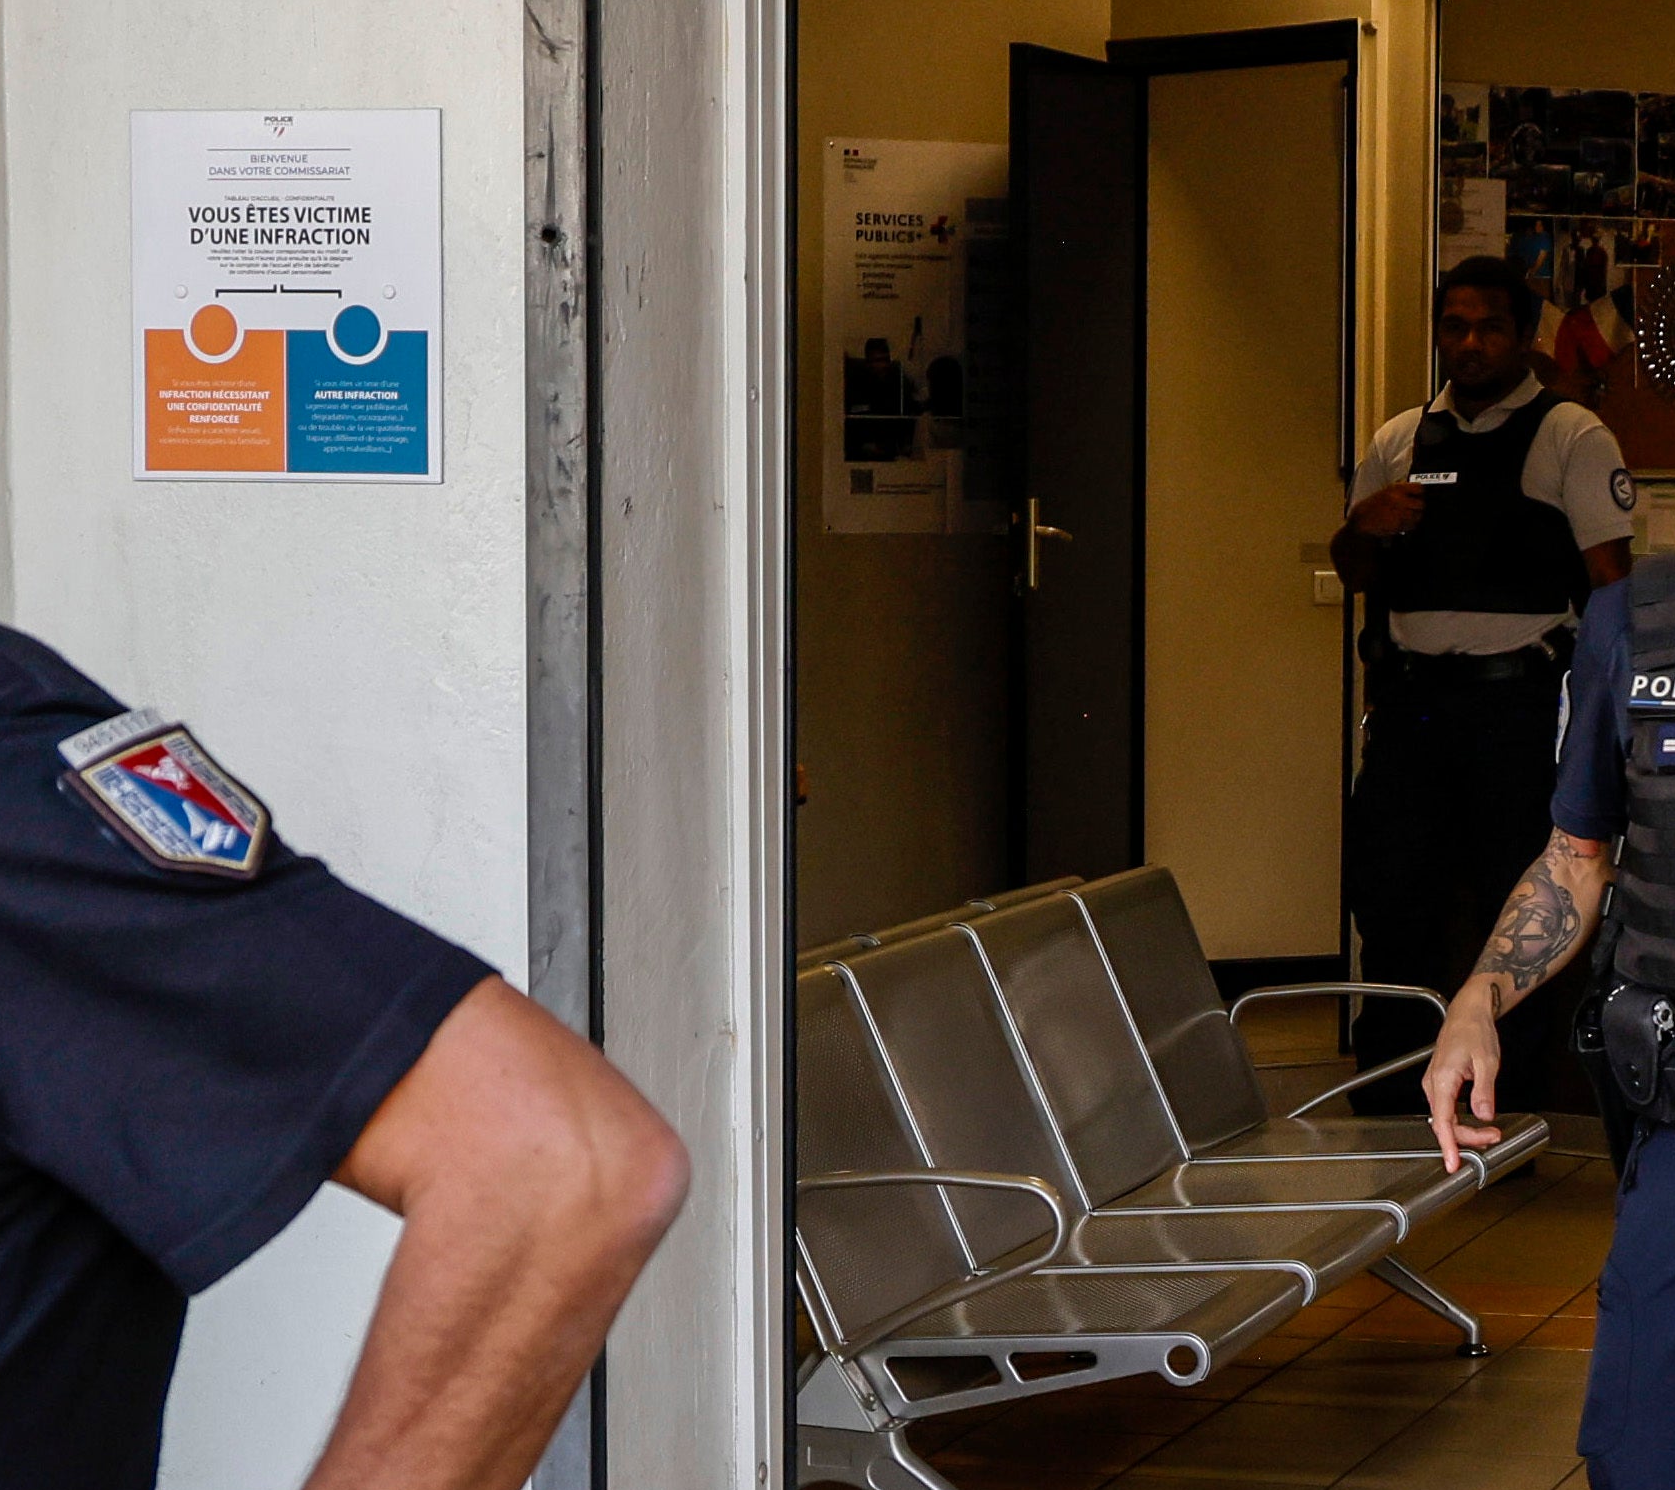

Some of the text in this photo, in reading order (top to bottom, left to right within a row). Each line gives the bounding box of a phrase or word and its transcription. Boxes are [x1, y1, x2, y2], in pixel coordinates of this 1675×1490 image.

[250, 154, 308, 164] BIENVENUE
[208, 166, 351, 176] DANS VOTRE COMMISSARIAT
[188, 203, 372, 224] VOUS ÊTES VICTIME
[855, 212, 924, 228] SERVICES
[190, 228, 370, 245] D'UNE INFRACTION
[159, 389, 270, 399] INFRACTION NÉCESSITANT
[314, 391, 398, 400] AUTRE INFRACTION
[167, 401, 262, 411] UNE CONFIDENTIALITÉ
[189, 413, 240, 424] RENFORCÉE
